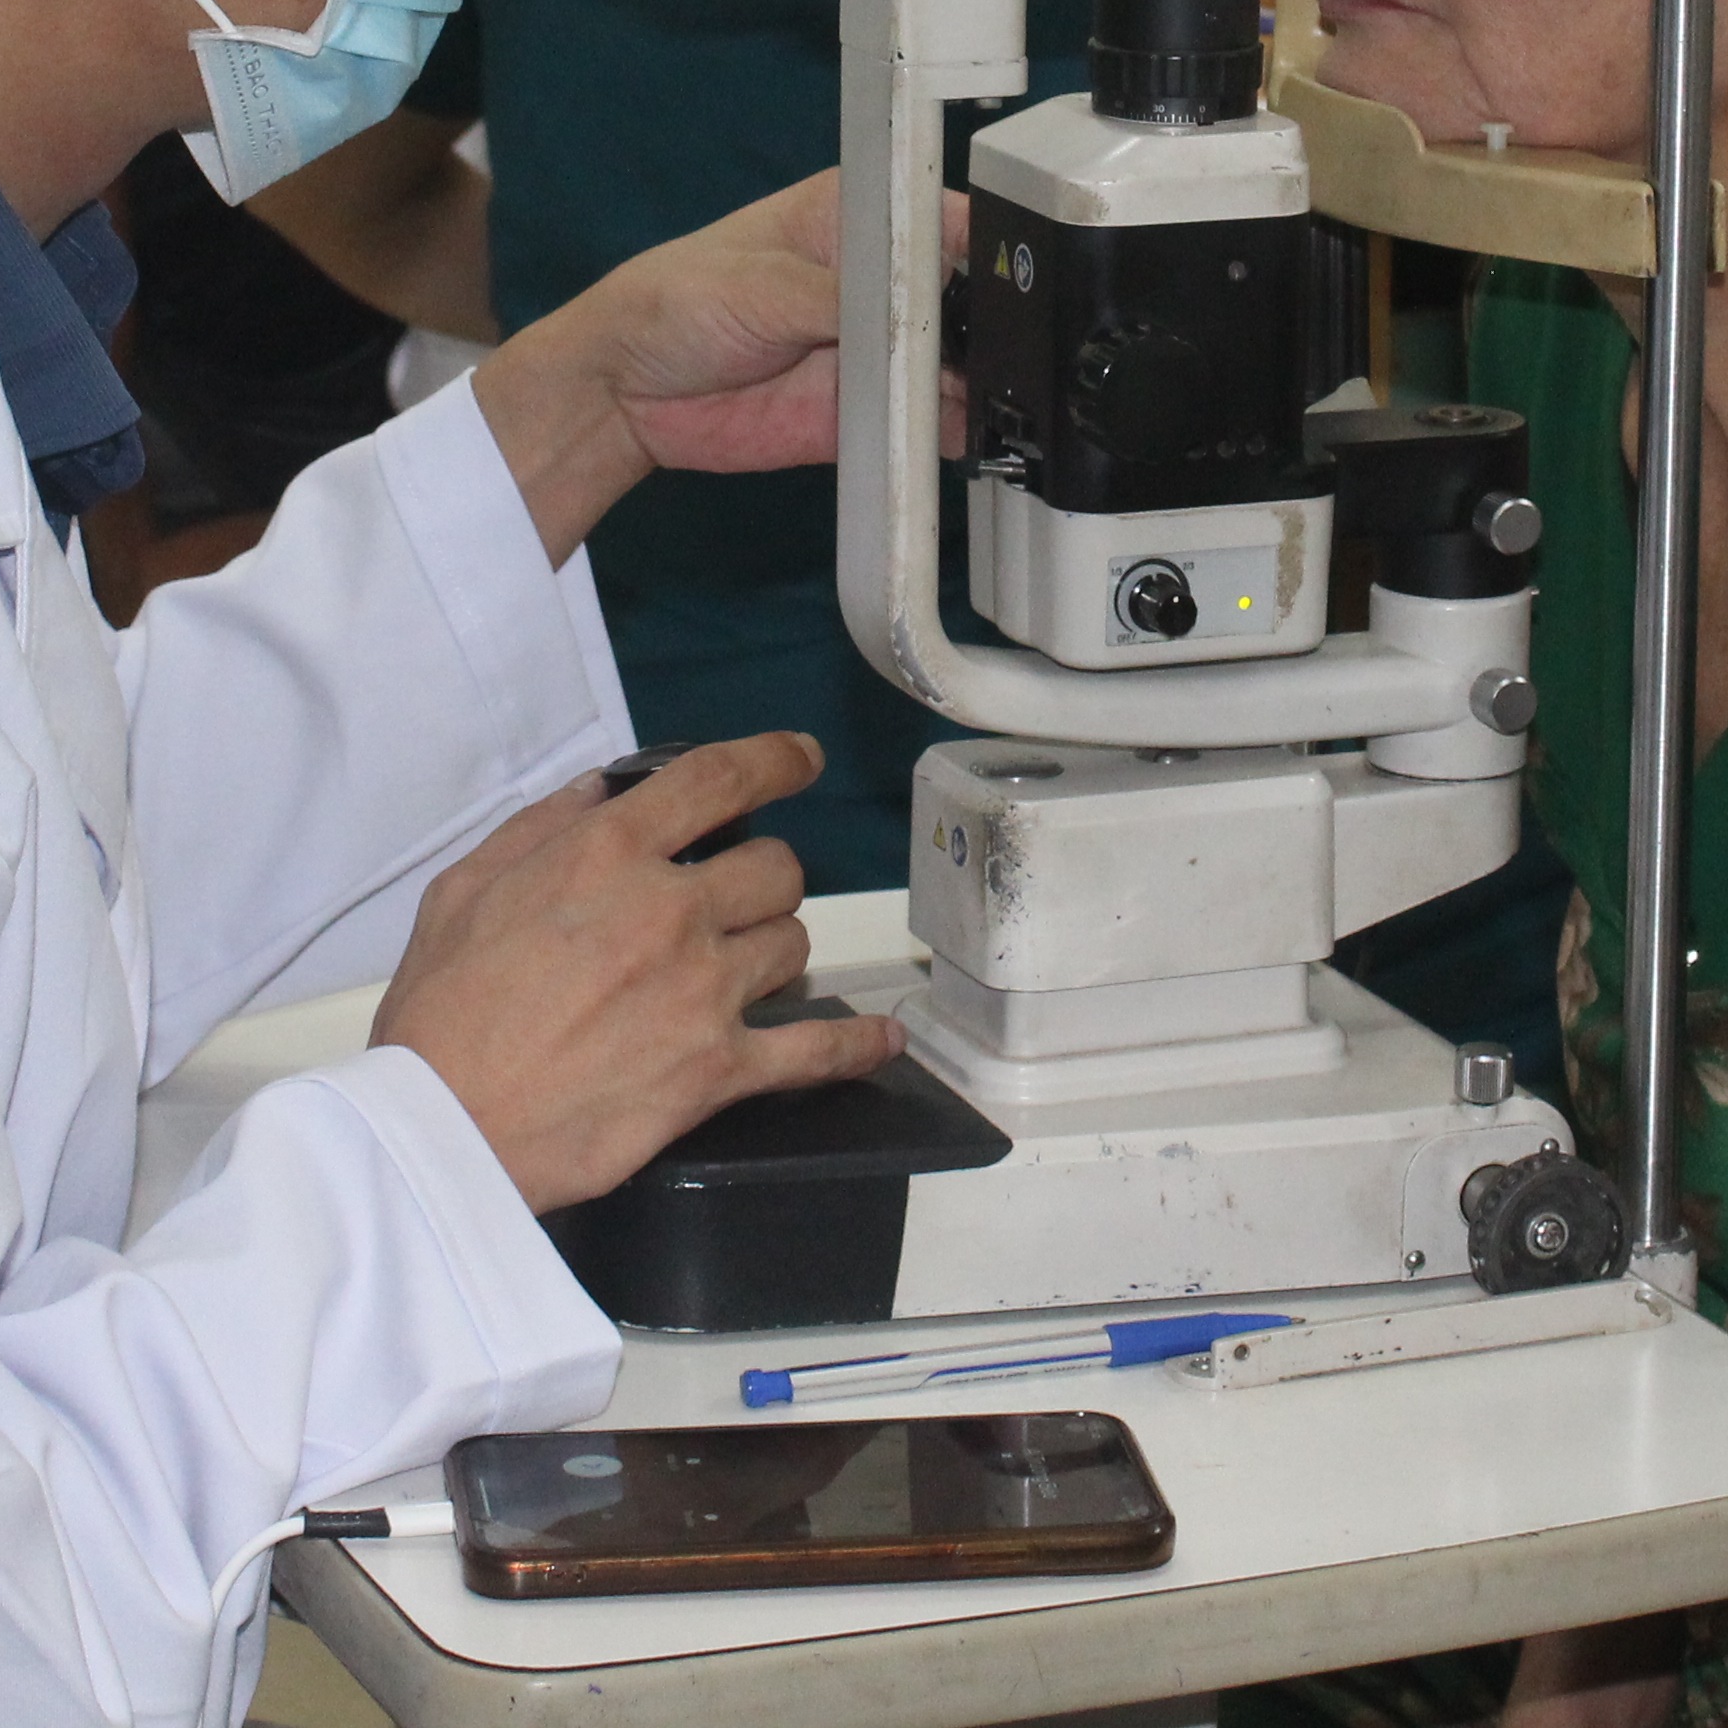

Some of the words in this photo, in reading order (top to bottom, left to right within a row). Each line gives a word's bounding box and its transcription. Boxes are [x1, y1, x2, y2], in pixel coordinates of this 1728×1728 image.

[245, 58, 269, 99] BAO
[258, 101, 283, 156] THAC
[1152, 103, 1165, 114] 30
[1199, 104, 1206, 114] 0
